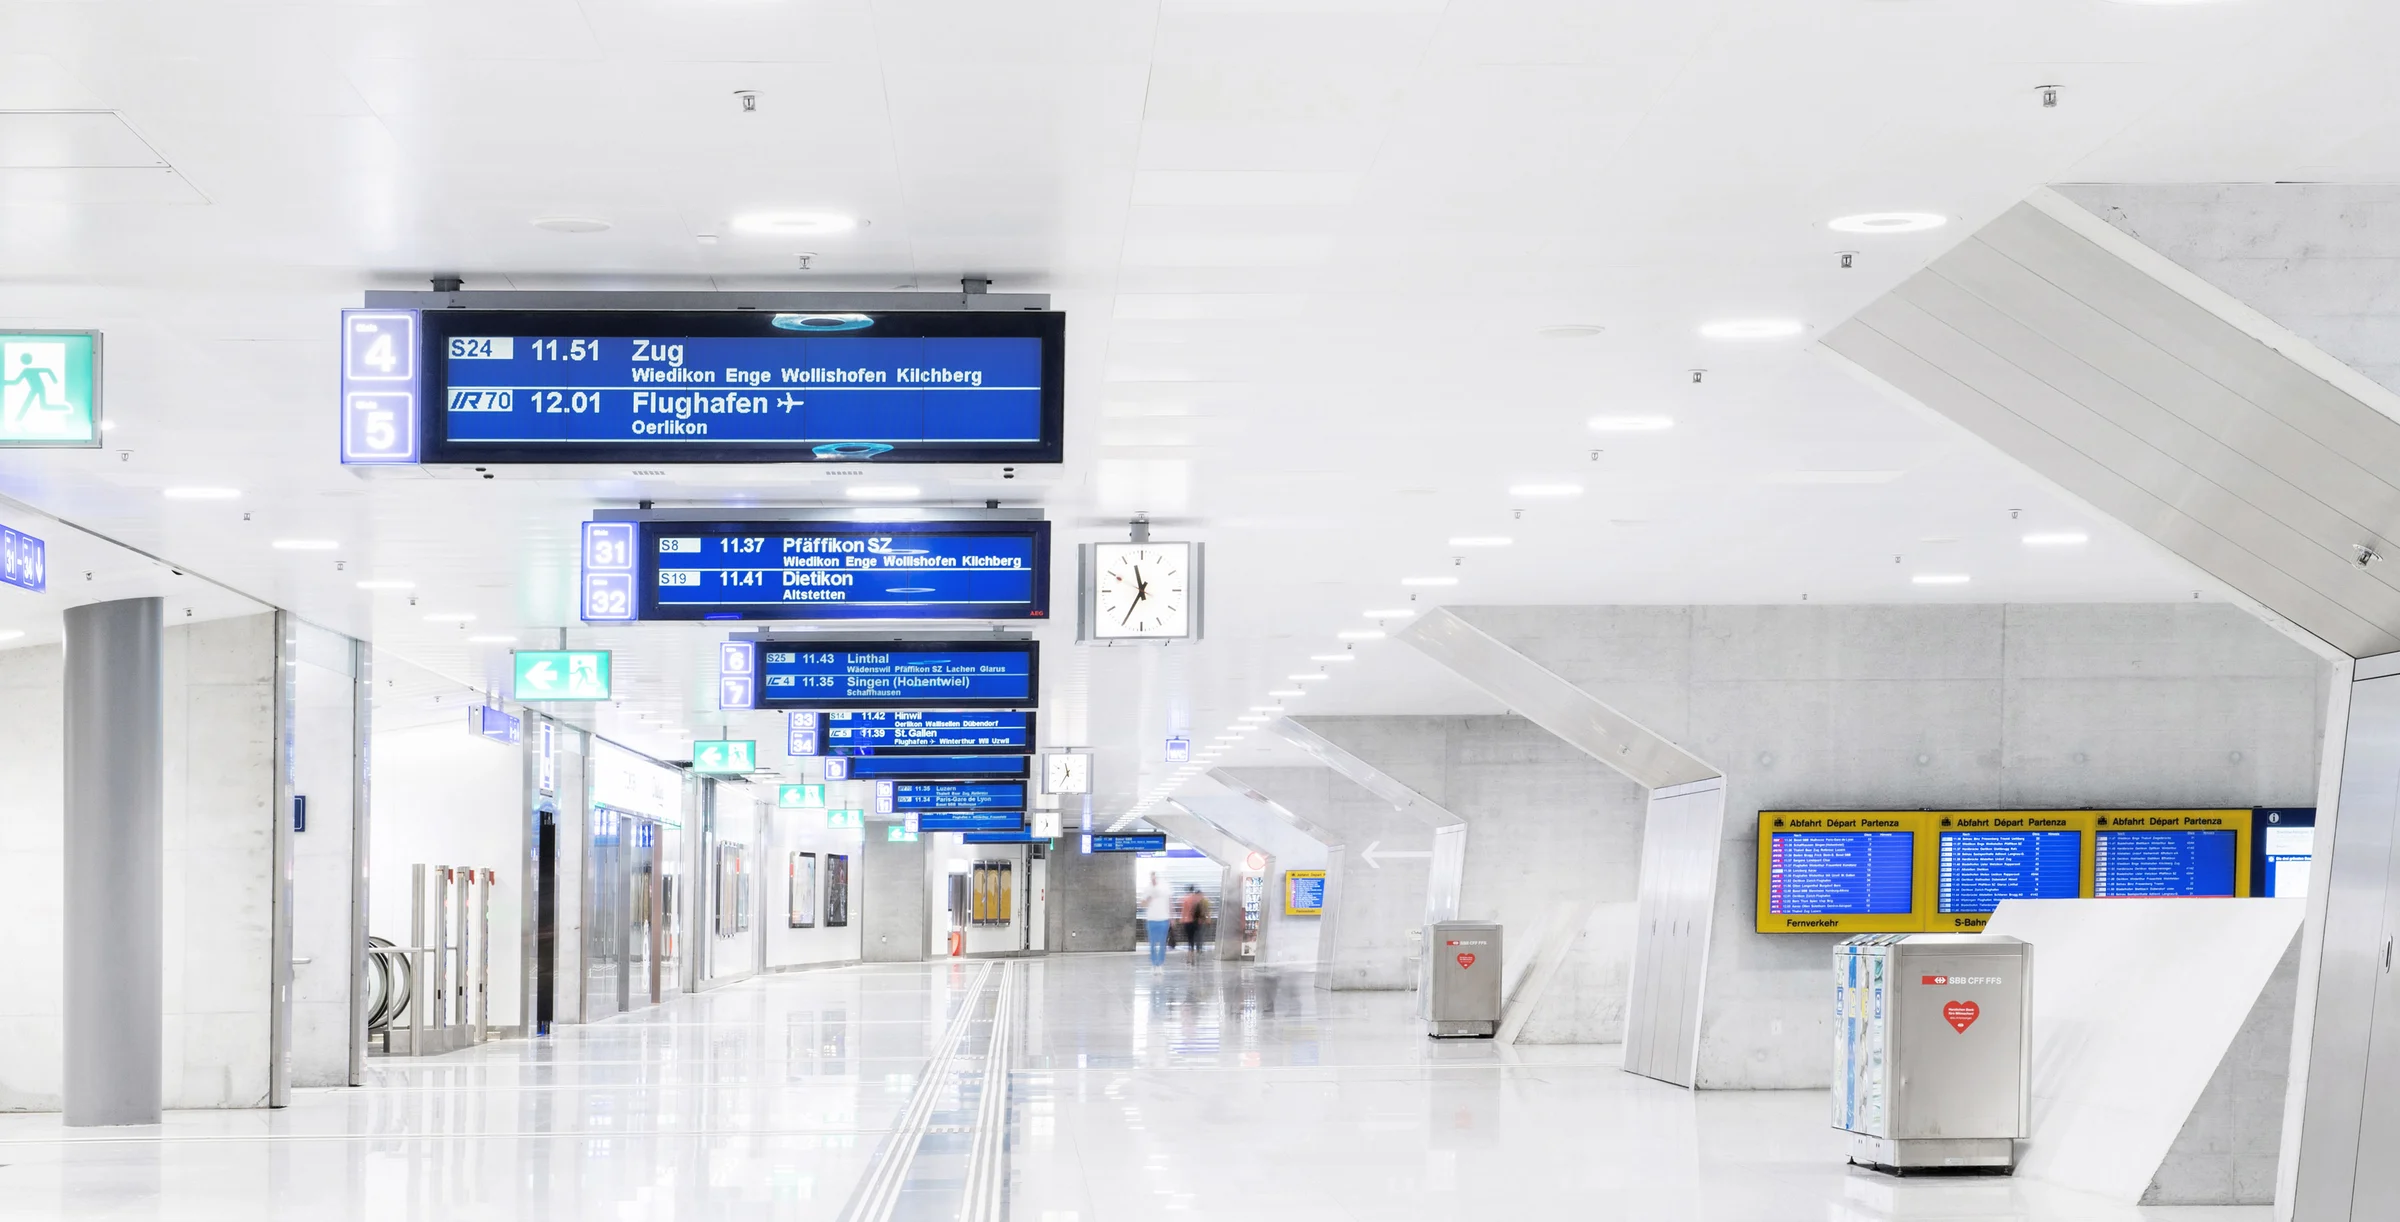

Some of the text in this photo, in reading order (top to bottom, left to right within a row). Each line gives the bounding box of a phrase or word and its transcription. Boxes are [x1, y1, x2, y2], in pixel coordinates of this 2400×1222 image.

[364, 334, 397, 373] 4
[452, 339, 683, 367] S24 11.51 Zug
[632, 368, 981, 386] Wiedikon Enge Wollishofen Kilchberg
[532, 392, 599, 413] 12.01
[634, 392, 767, 419] Flughafen
[365, 412, 395, 450] 5
[632, 420, 707, 434] Oerlikon
[595, 540, 625, 564] 31
[662, 538, 893, 554] S8 11.37 Pfäffikon SZ
[6, 549, 15, 574] 31
[24, 556, 33, 580] 34
[784, 555, 1023, 568] Wiedikon Enge Wollishofen Kilchberg
[661, 571, 854, 586] S19 11.41 Dietikon
[592, 590, 625, 613] 32
[783, 590, 845, 599] Altstetten
[730, 652, 744, 670] 6
[767, 653, 888, 663] S25 11.43 Linthal
[803, 677, 833, 686] 11.35
[848, 677, 889, 689] Singen
[894, 677, 969, 688] (Hohentwiel)
[729, 685, 744, 704] 7
[794, 713, 813, 726] 33
[861, 712, 886, 720] 11.42
[861, 729, 886, 737] 11.39
[894, 729, 907, 737] St.
[907, 729, 937, 737] Gallen
[793, 739, 812, 752] 34
[1827, 819, 1856, 828] Départ
[1862, 819, 1898, 827] Partenza
[1995, 819, 2023, 827] Départ
[2150, 818, 2178, 826] Départ
[2184, 817, 2221, 825] Partenza
[1787, 919, 1838, 927] Fernverkehr
